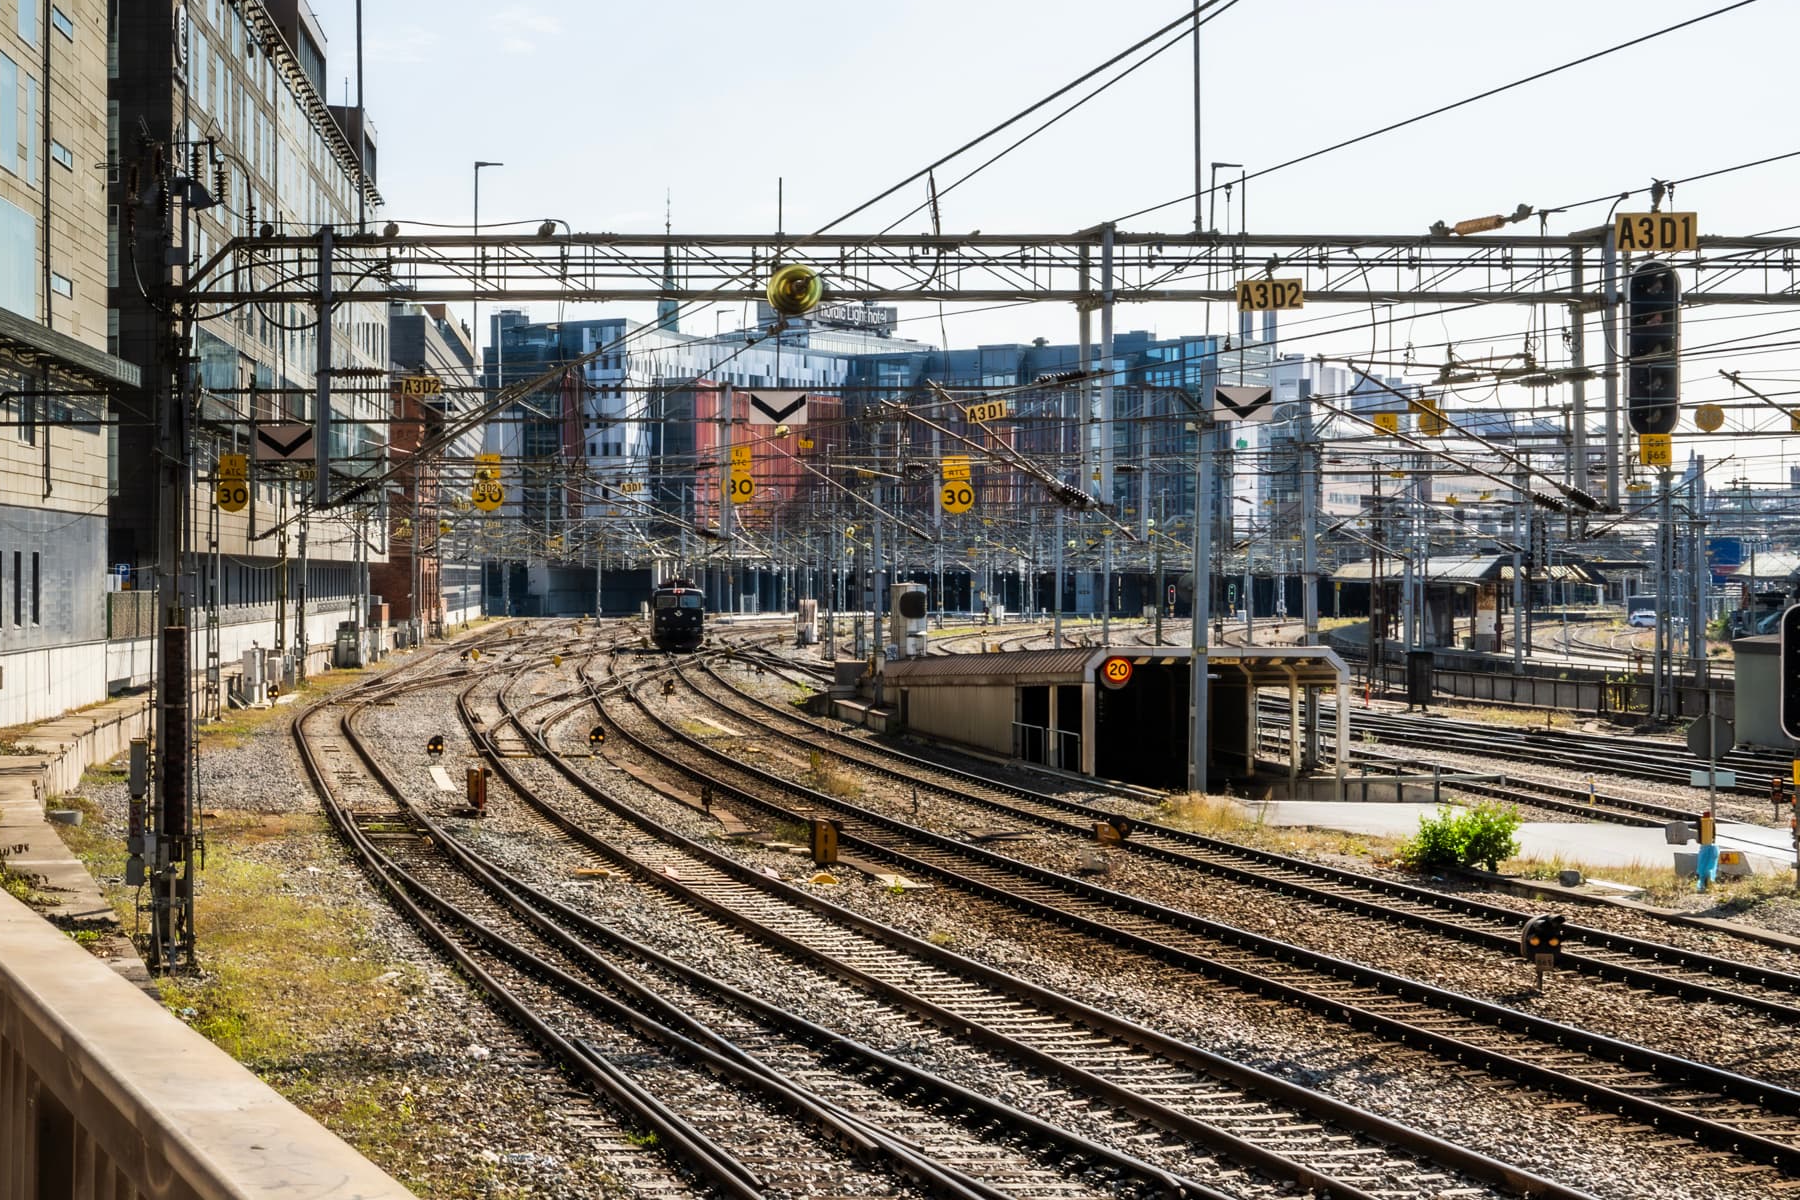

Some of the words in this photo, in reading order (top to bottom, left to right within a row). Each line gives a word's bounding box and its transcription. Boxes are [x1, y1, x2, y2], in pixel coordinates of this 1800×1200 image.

[220, 488, 247, 503] 30
[944, 489, 972, 505] 30
[1110, 663, 1128, 676] 20
